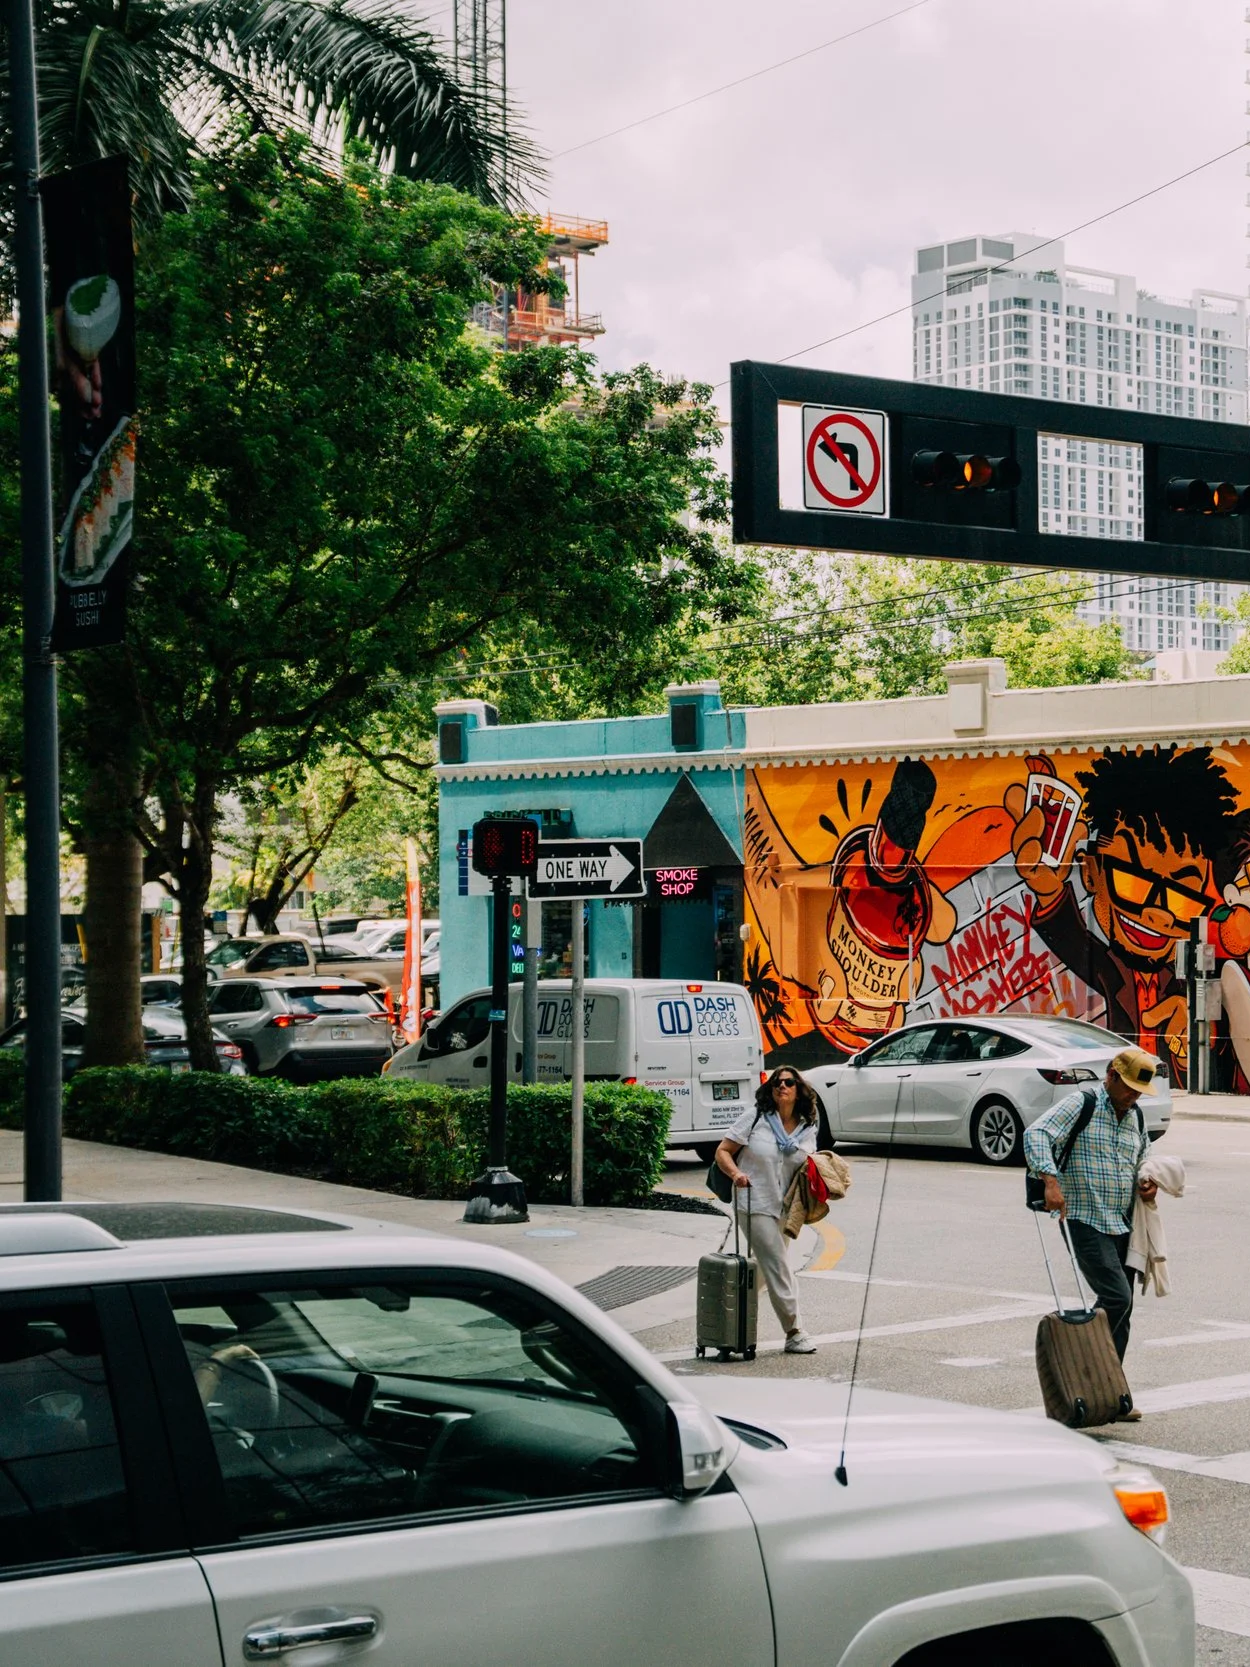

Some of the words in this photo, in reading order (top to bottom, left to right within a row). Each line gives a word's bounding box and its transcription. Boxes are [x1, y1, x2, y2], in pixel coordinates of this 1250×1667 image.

[546, 861, 574, 879] ONE
[579, 859, 608, 878] WAY
[656, 869, 699, 883] SMOKE
[661, 882, 695, 896] SHOP
[837, 924, 897, 981] MONKEY
[830, 938, 897, 998] SHOULDER
[693, 997, 737, 1012] DASH
[696, 1011, 728, 1024] DOOR
[698, 1024, 740, 1037] GLASS
